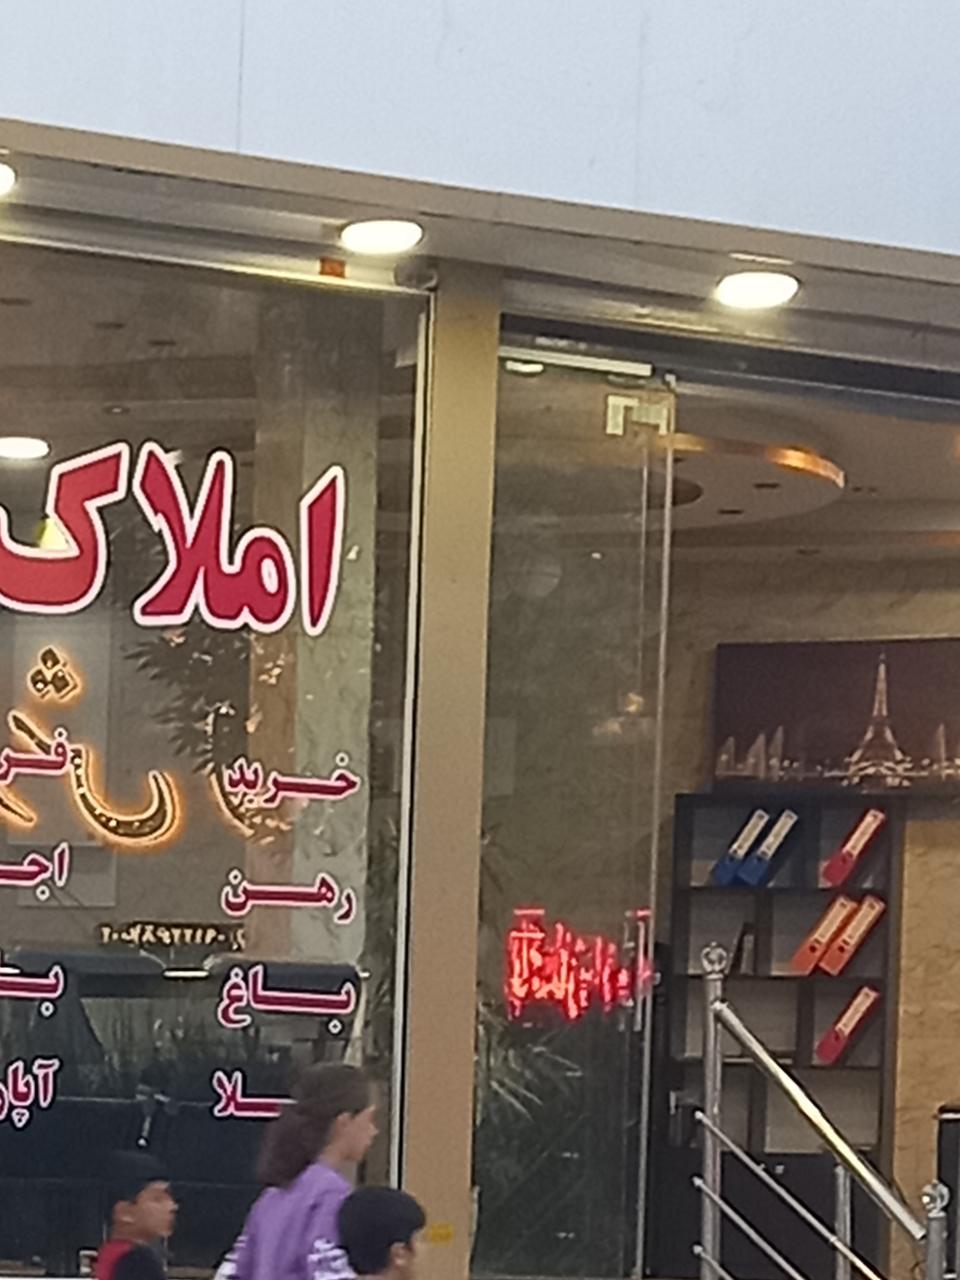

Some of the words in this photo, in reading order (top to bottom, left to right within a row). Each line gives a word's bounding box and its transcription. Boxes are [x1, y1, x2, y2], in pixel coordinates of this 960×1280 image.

[224, 752, 360, 808] خرید
[221, 869, 356, 924] رهن
[217, 964, 356, 1034] باغ
